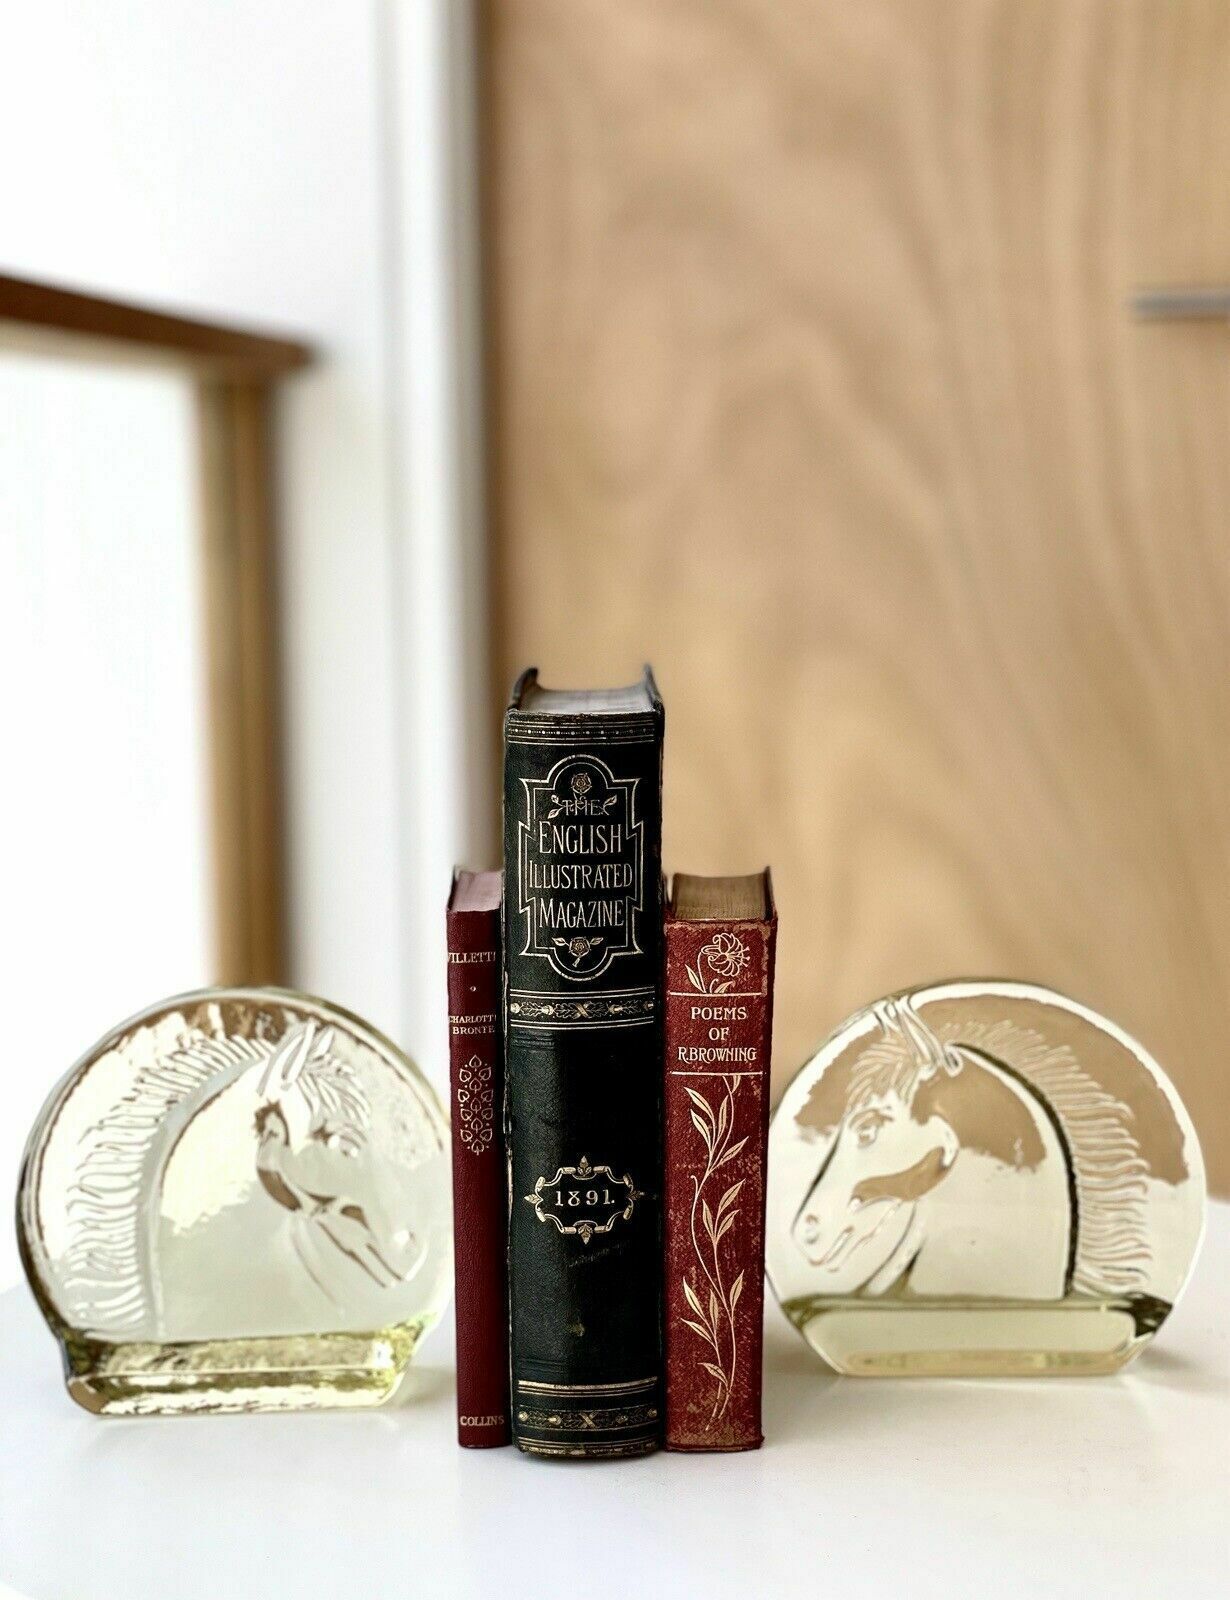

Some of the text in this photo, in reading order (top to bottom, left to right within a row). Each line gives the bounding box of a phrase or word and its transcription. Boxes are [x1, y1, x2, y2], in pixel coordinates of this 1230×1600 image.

[561, 799, 600, 816] THE
[538, 820, 622, 854] ENGLISH
[529, 860, 633, 889] ILLUSTRATED
[538, 898, 624, 928] MAGAZINE
[447, 1015, 497, 1024] CHARLOTT
[690, 1006, 748, 1021] POEMS
[452, 1026, 495, 1035] BRONTE
[708, 1027, 730, 1041] OF
[677, 1046, 757, 1064] R.BROWNING
[555, 1189, 615, 1207] 1891.
[459, 1415, 505, 1427] COLLINS
